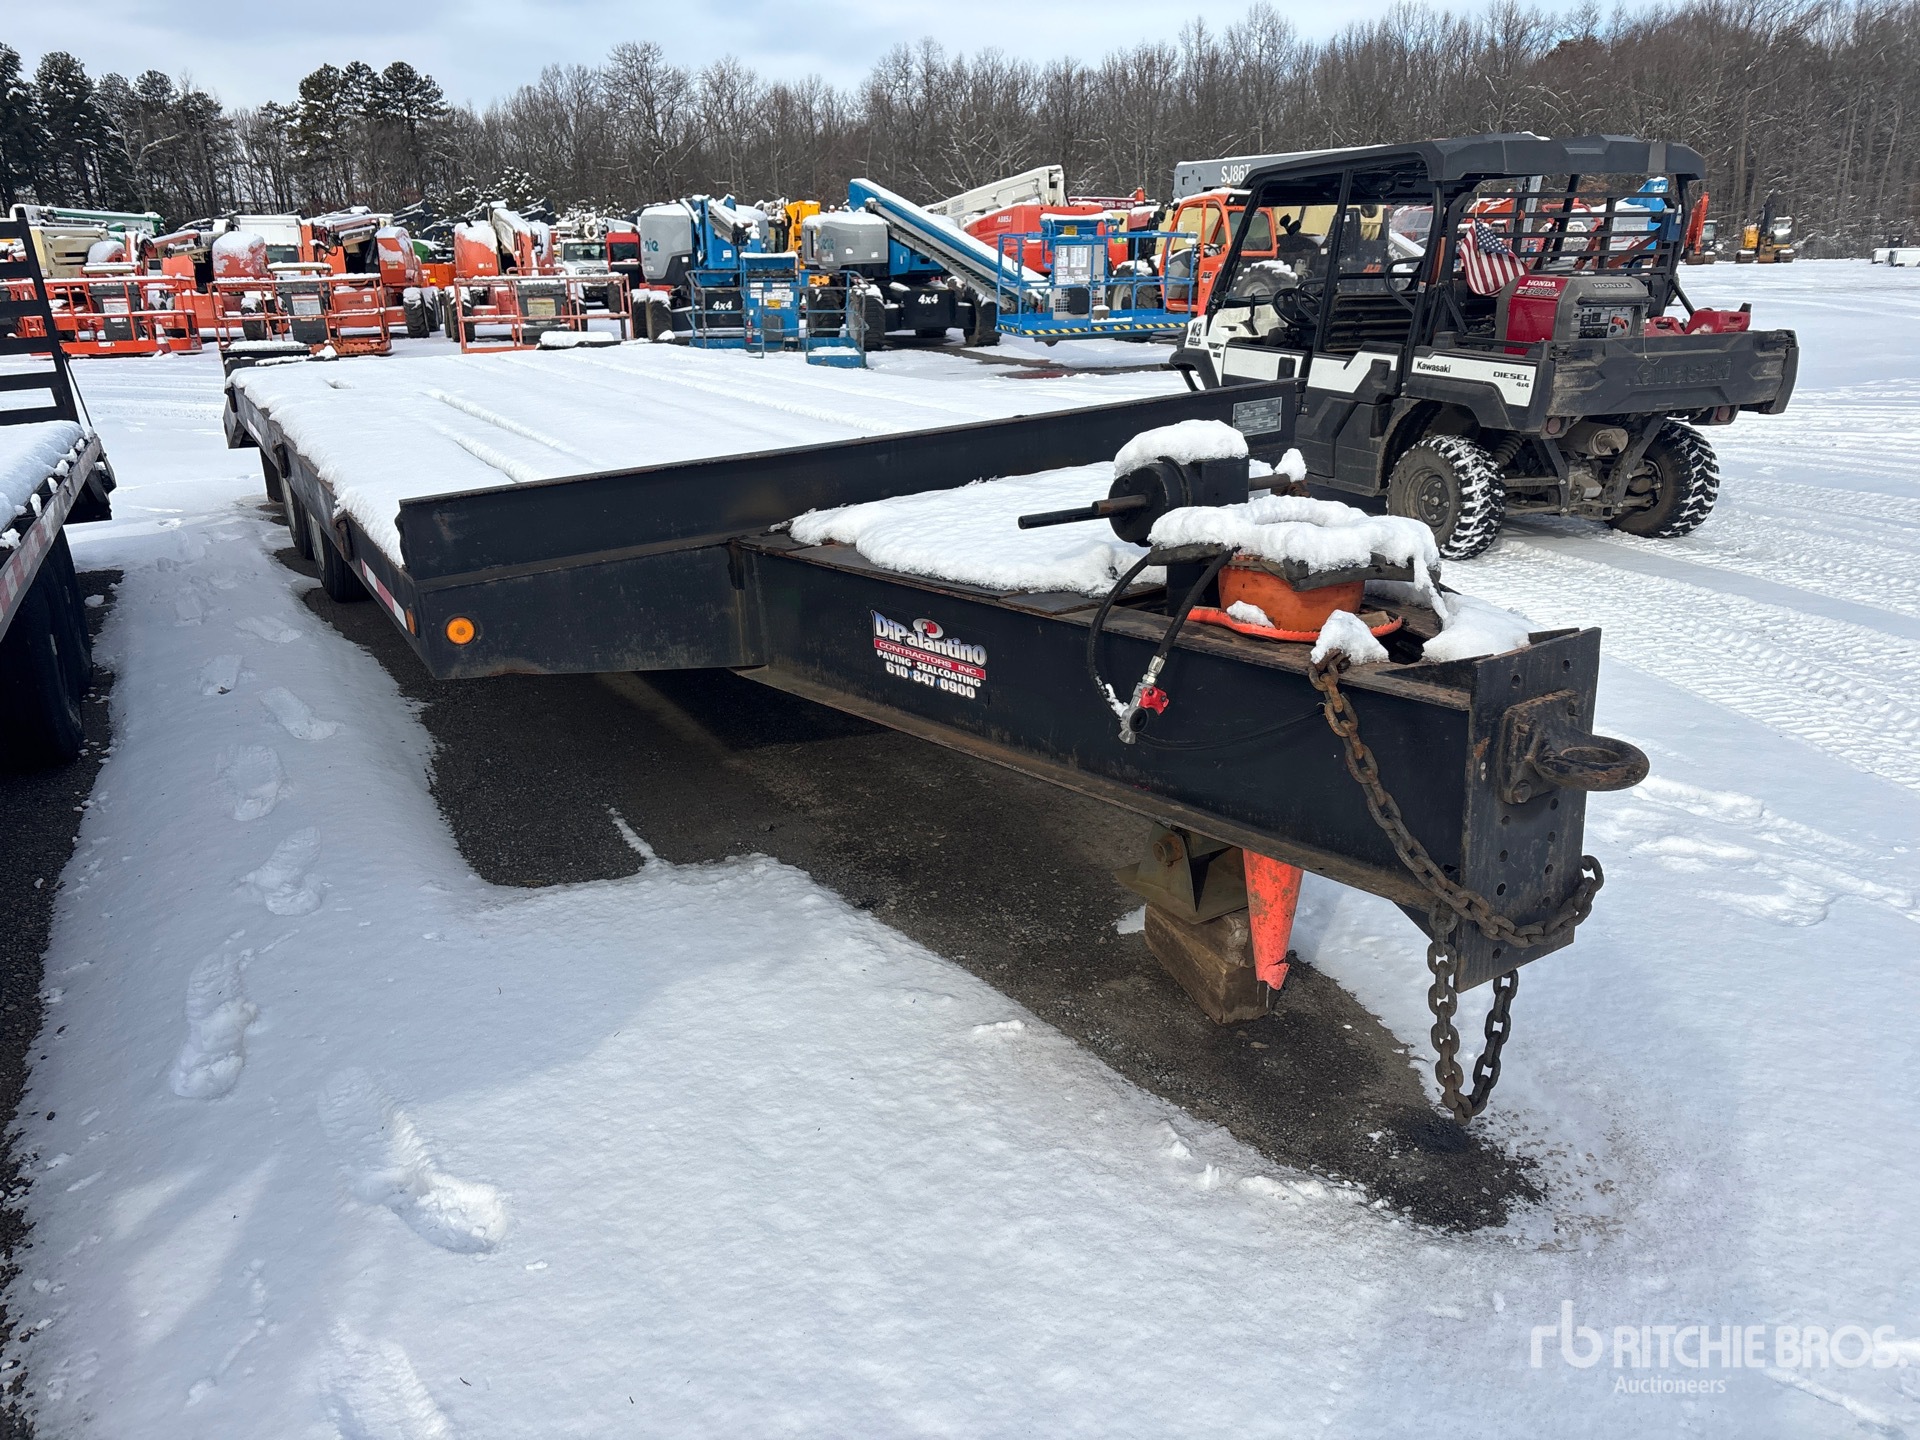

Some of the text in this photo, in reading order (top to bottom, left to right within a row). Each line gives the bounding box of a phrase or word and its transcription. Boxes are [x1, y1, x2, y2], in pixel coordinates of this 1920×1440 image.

[1526, 280, 1557, 288] HONDA
[713, 300, 733, 311] 4x4
[918, 294, 940, 305] 4x4
[1416, 360, 1452, 374] Kawasaki
[1492, 371, 1531, 382] DIESEL
[871, 609, 988, 667] DiPalantino
[879, 642, 980, 677] CONTRACTORS INC.
[876, 649, 982, 688] PAVING SEALCOATING
